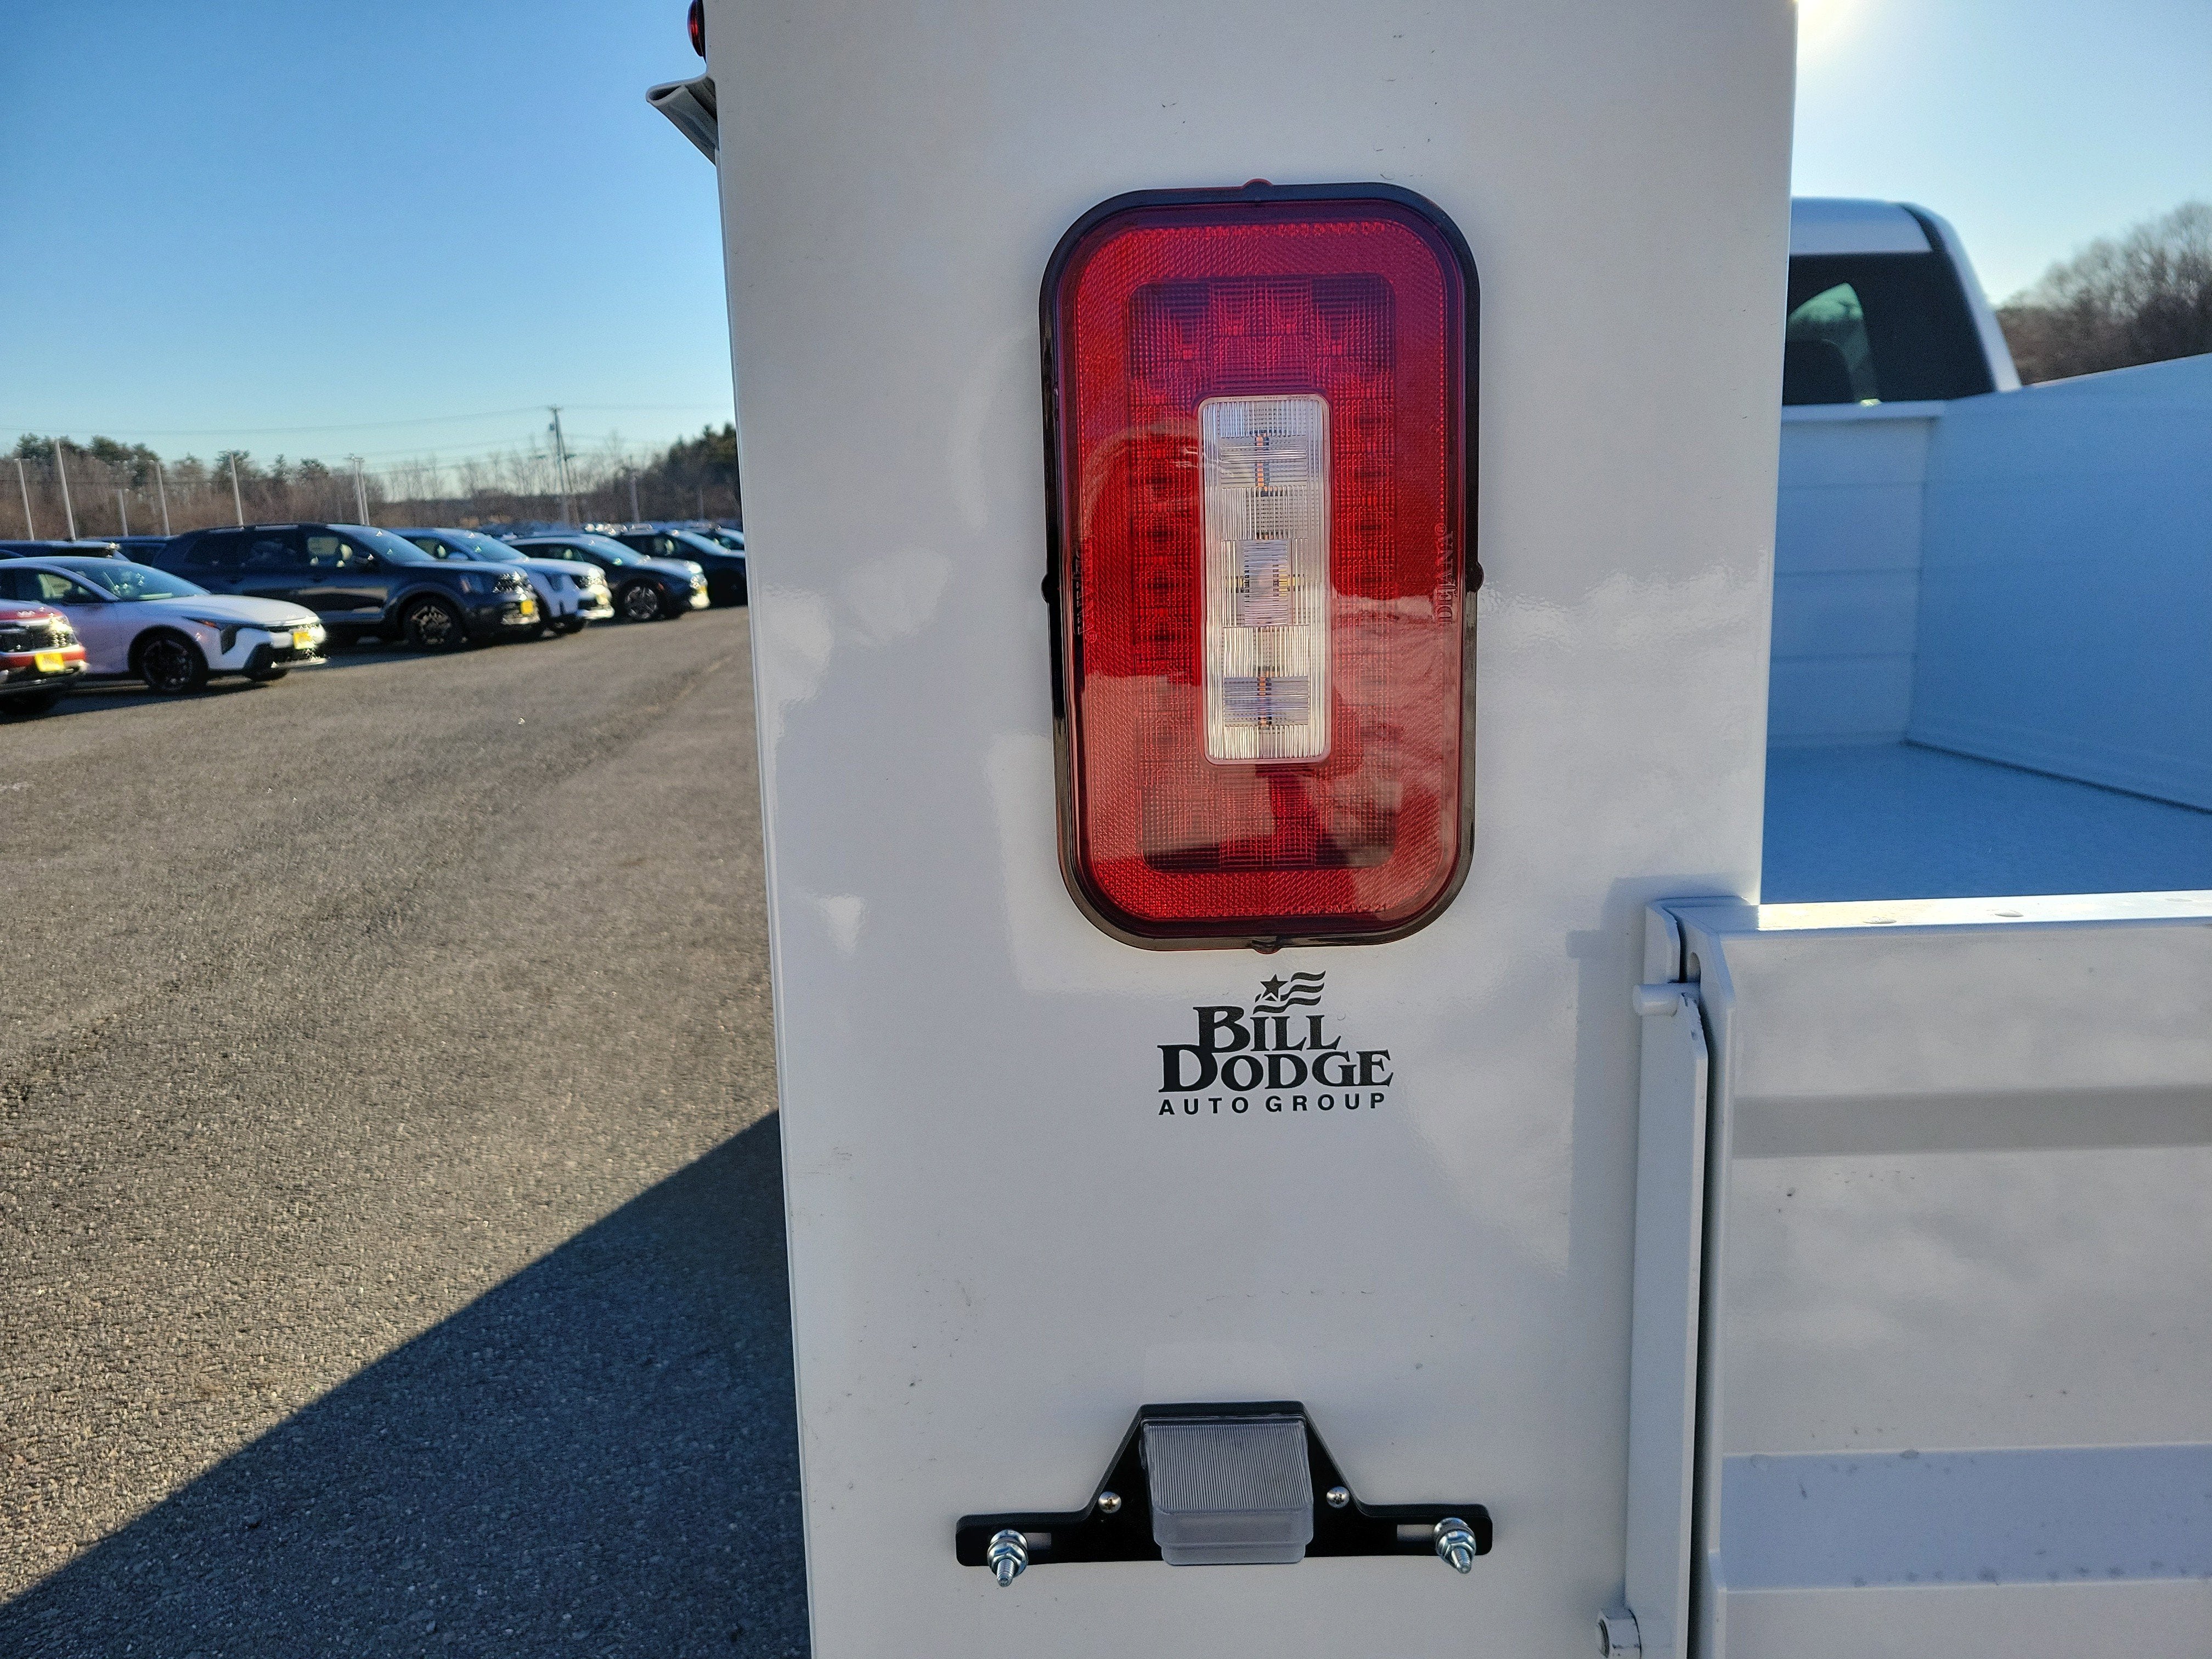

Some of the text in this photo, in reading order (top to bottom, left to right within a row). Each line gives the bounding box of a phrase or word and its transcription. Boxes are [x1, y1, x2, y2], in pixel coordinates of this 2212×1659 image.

[1193, 1006, 1341, 1053] BILL
[1156, 1043, 1394, 1093] DODGE
[1158, 1092, 1385, 1116] AUTO GROUP
